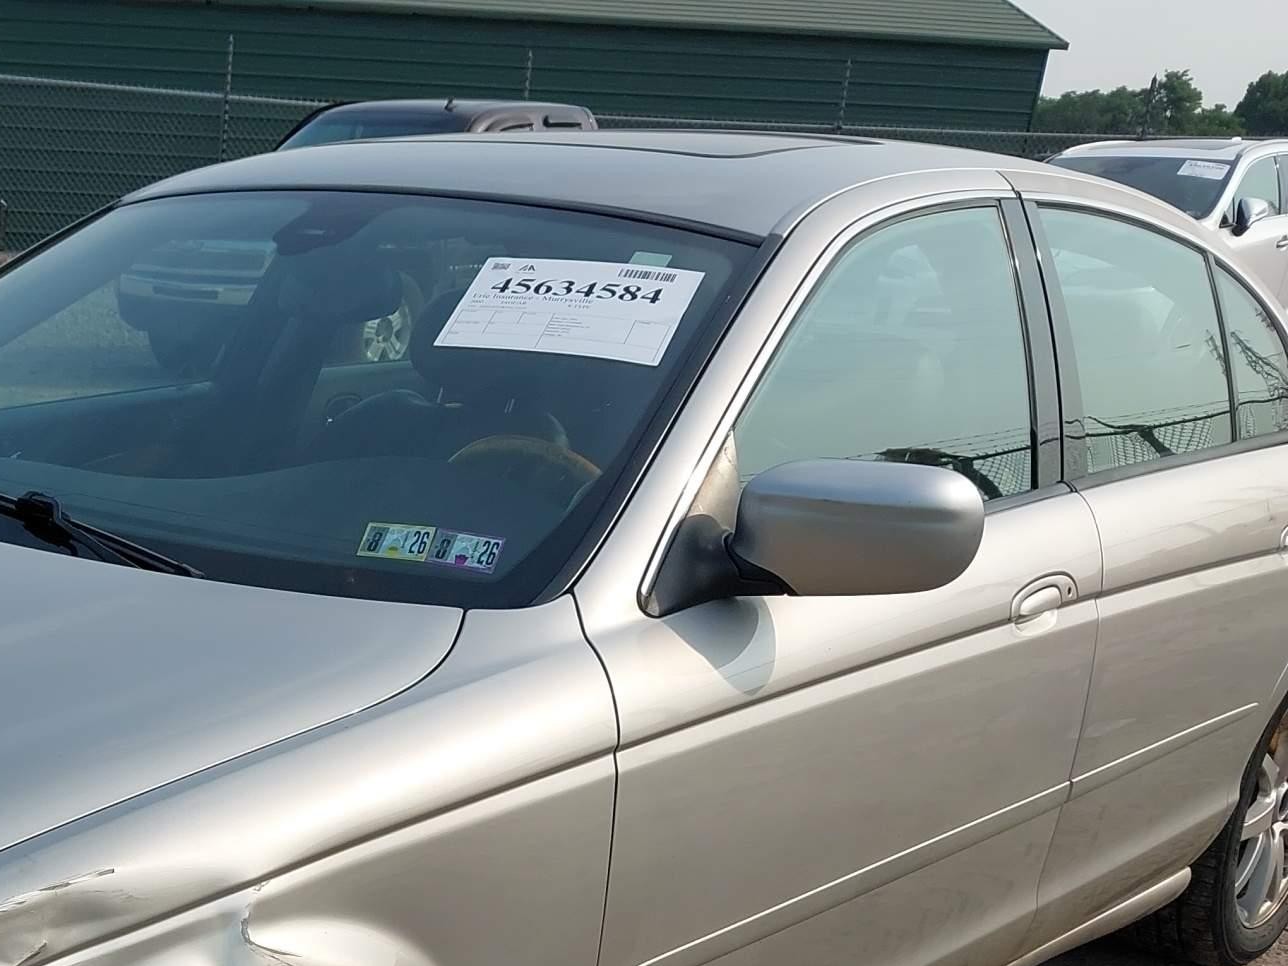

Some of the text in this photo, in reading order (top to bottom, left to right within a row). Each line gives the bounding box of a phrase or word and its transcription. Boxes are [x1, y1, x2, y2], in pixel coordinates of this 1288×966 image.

[491, 277, 664, 304] 45634584
[366, 531, 430, 554] 8 26
[435, 538, 500, 565] 8 26
